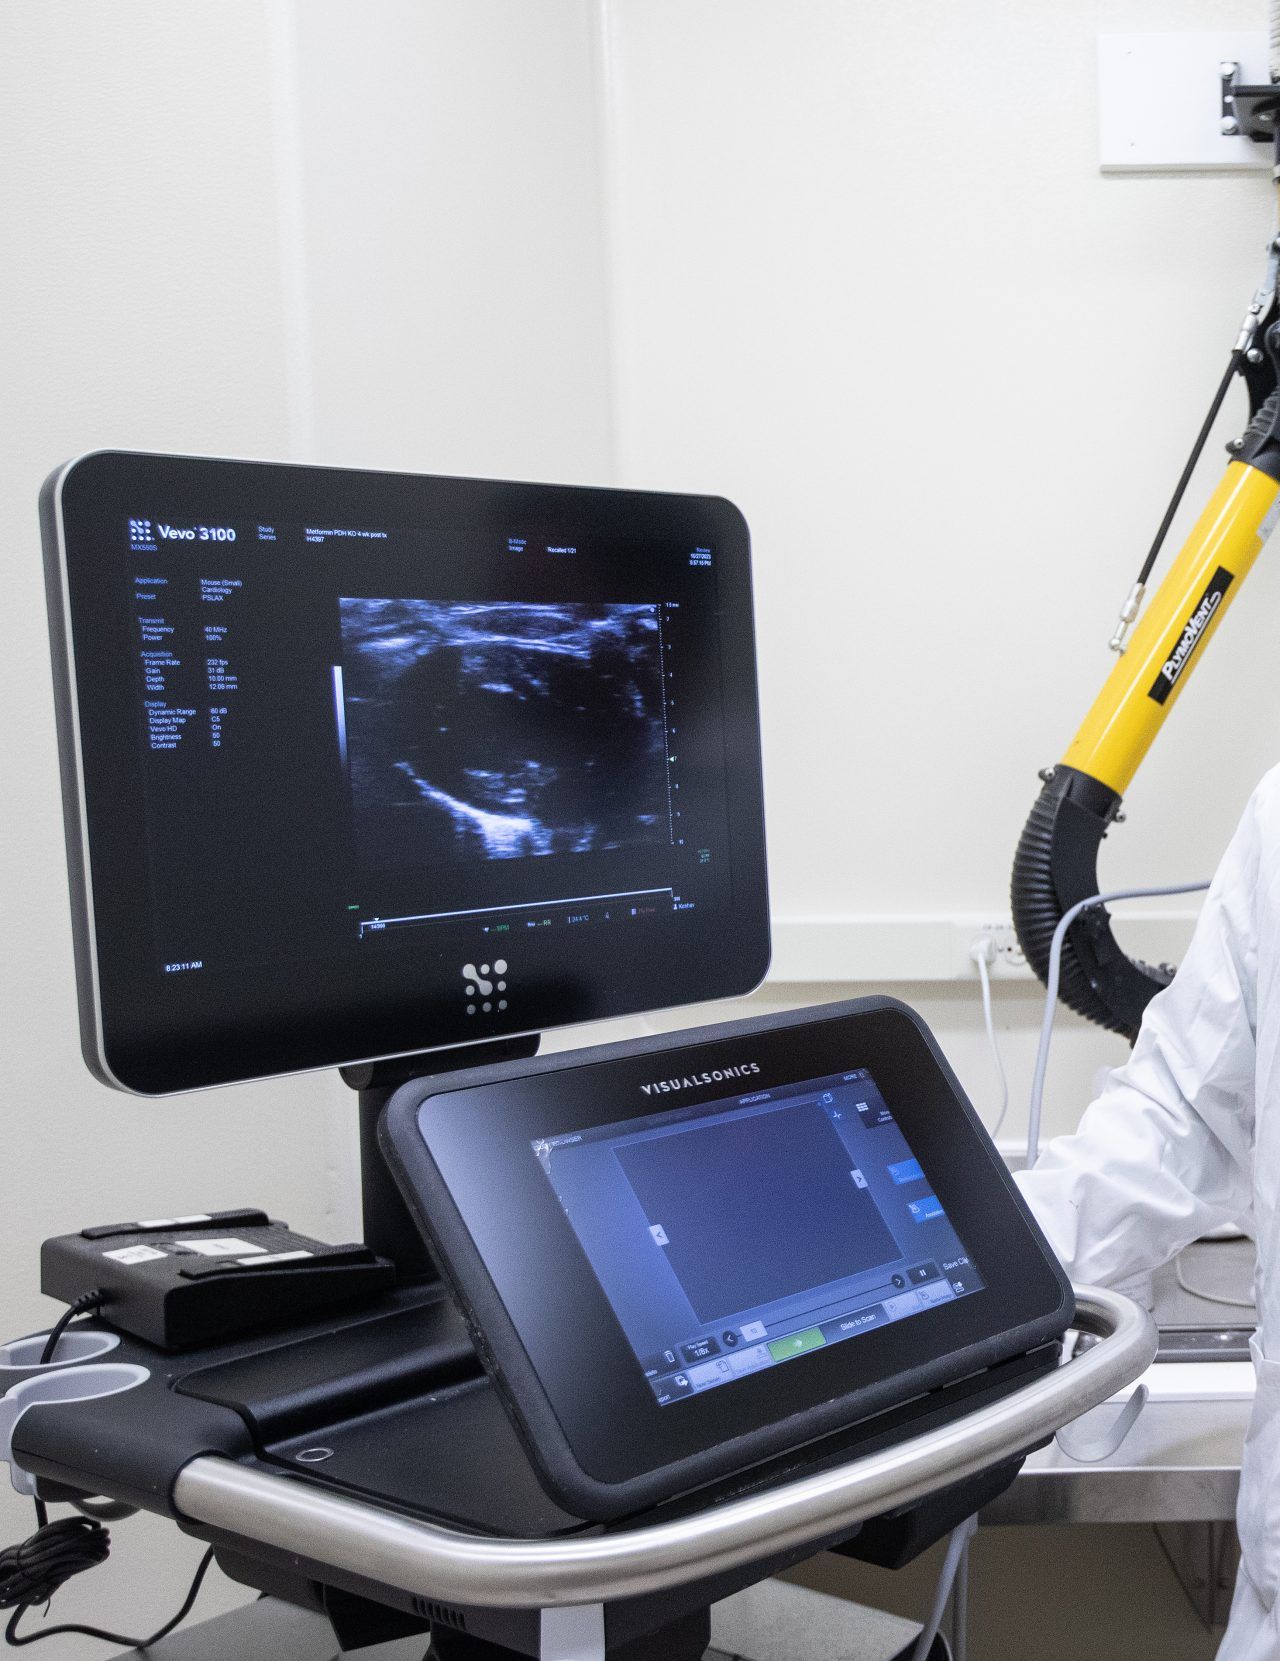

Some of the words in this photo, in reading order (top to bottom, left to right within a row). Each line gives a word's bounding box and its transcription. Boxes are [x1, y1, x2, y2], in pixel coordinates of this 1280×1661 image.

[158, 524, 195, 540] Vevo
[200, 527, 236, 541] 3100
[258, 525, 275, 534] Study
[258, 533, 277, 541] Series
[134, 577, 168, 586] Application
[221, 579, 243, 587] (Small)
[201, 587, 233, 595] Cardiology
[142, 626, 175, 634] Frequency
[219, 659, 229, 667] fps
[146, 675, 165, 683] Depth
[176, 708, 197, 716] Range
[190, 961, 203, 969] AM
[641, 1062, 760, 1095] VISUALSONICS
[739, 1093, 771, 1104] APPLICATION
[942, 1261, 958, 1270] Save
[840, 1321, 856, 1331] Slide
[861, 1313, 877, 1324] Scan
